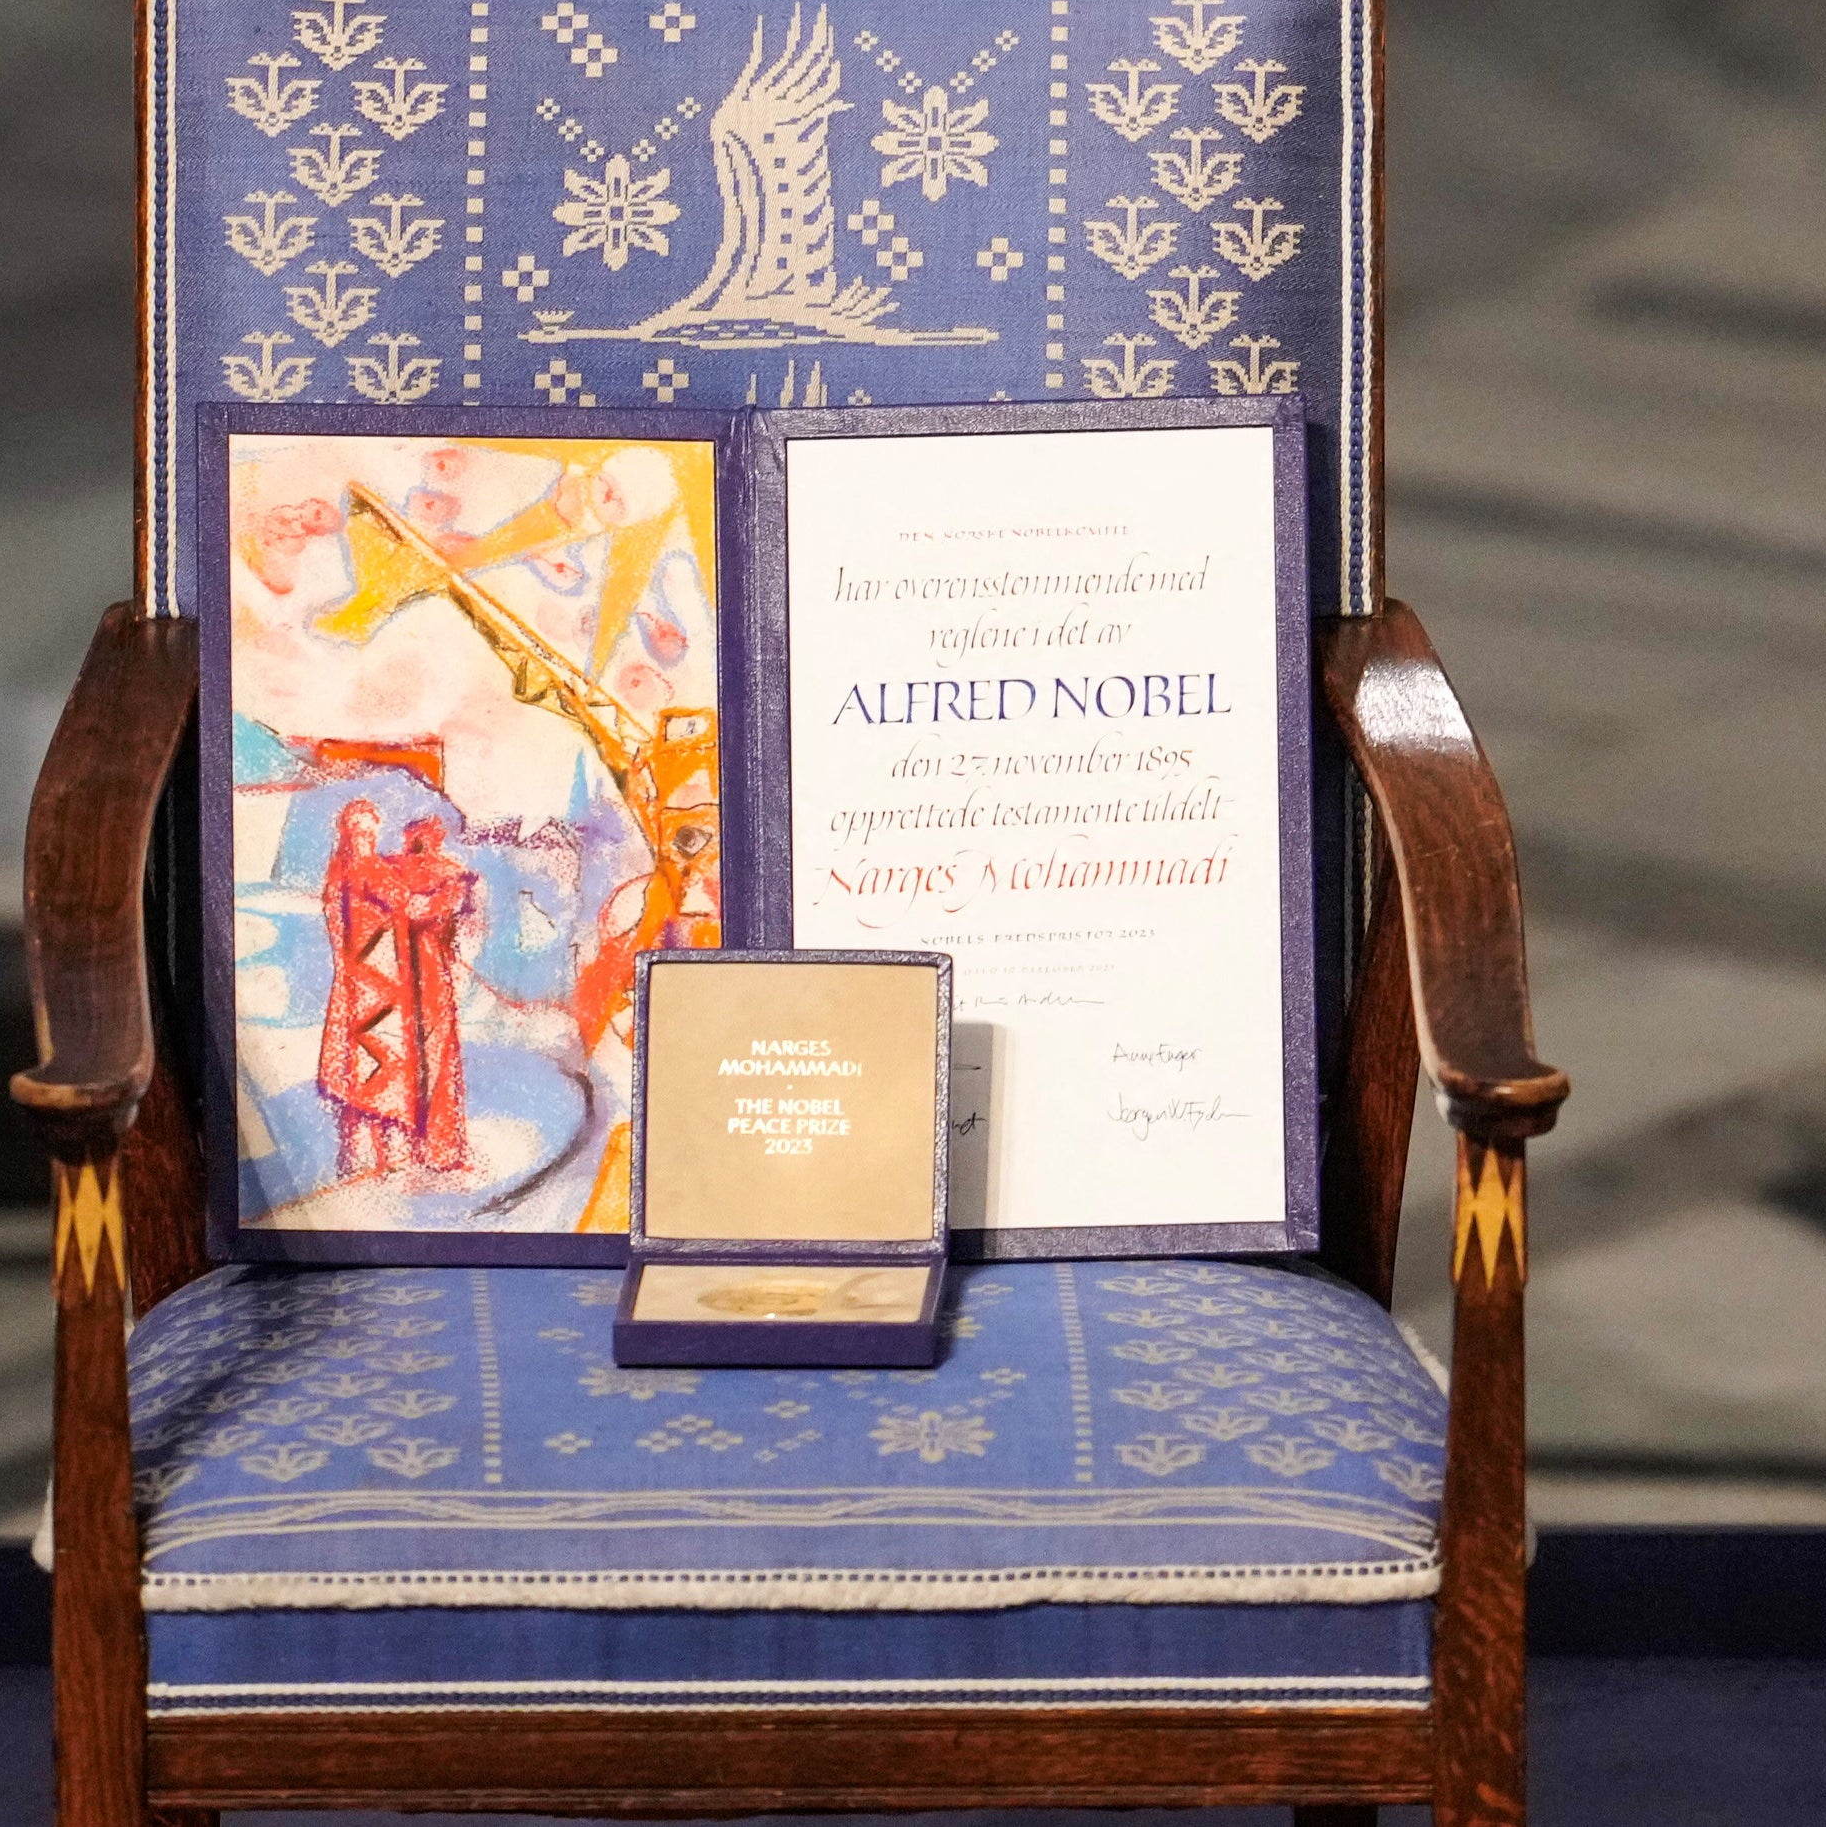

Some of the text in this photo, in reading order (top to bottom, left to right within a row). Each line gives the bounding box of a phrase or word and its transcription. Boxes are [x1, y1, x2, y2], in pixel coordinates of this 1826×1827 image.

[834, 567, 889, 602] har
[1150, 555, 1210, 593] med
[930, 608, 1026, 668] reglene
[1046, 602, 1089, 646] det
[1097, 622, 1132, 644] av
[832, 673, 1232, 725] ALFRED NOBEL
[891, 734, 941, 778] den
[993, 731, 1131, 776] november
[1136, 745, 1193, 780] 1895
[830, 776, 1235, 850] opprettede testamente tildelt
[812, 834, 1239, 929] Narges Mohammadi
[1119, 929, 1155, 938] 2023
[751, 1040, 832, 1056] NARGES
[718, 1058, 862, 1076] MOHAMMADI
[734, 1098, 844, 1115] THE NOBEL
[727, 1118, 851, 1135] PEACE PRIZE
[765, 1138, 813, 1154] 2023
